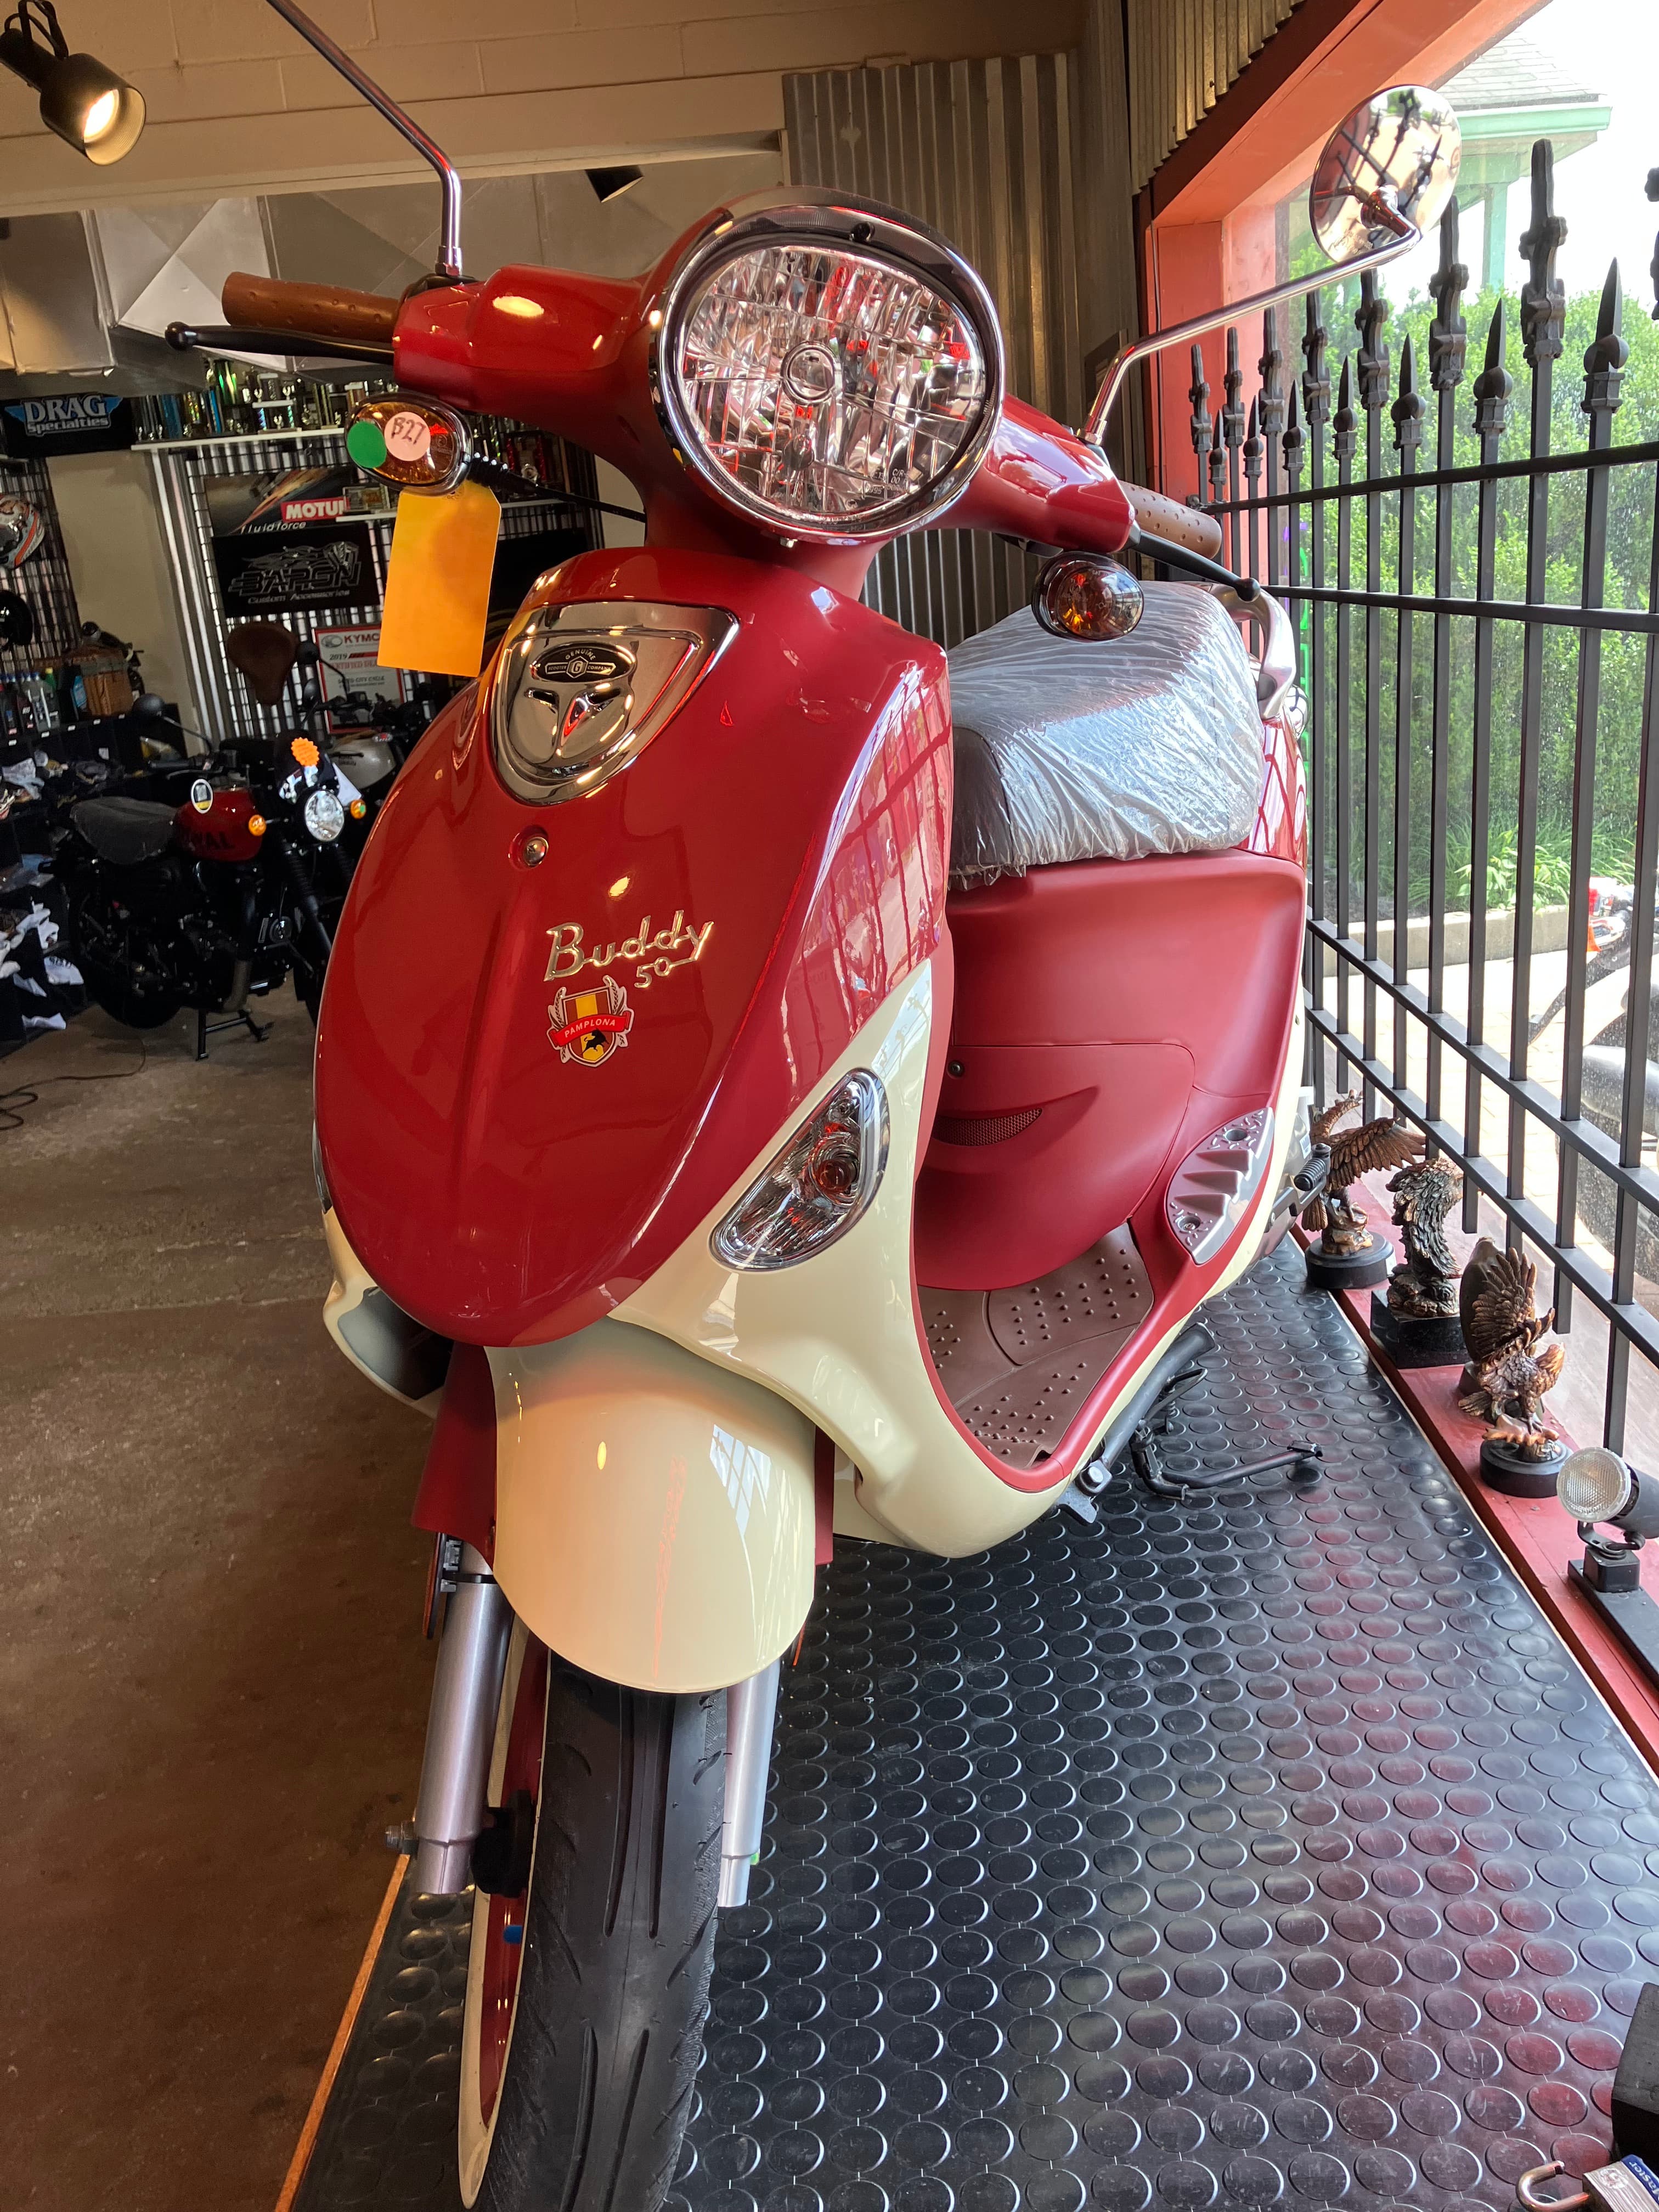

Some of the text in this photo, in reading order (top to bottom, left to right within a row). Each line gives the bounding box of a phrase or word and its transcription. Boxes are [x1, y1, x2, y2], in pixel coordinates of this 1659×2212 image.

[24, 394, 106, 422] DRAG
[27, 417, 109, 434] Specialties
[391, 416, 427, 445] B27
[247, 589, 351, 604] Custom Accessories
[344, 633, 381, 644] KYMC
[571, 660, 584, 674] G
[543, 910, 714, 982] Buddy
[634, 957, 672, 988] 50
[564, 1018, 617, 1038] PAMPLONA
